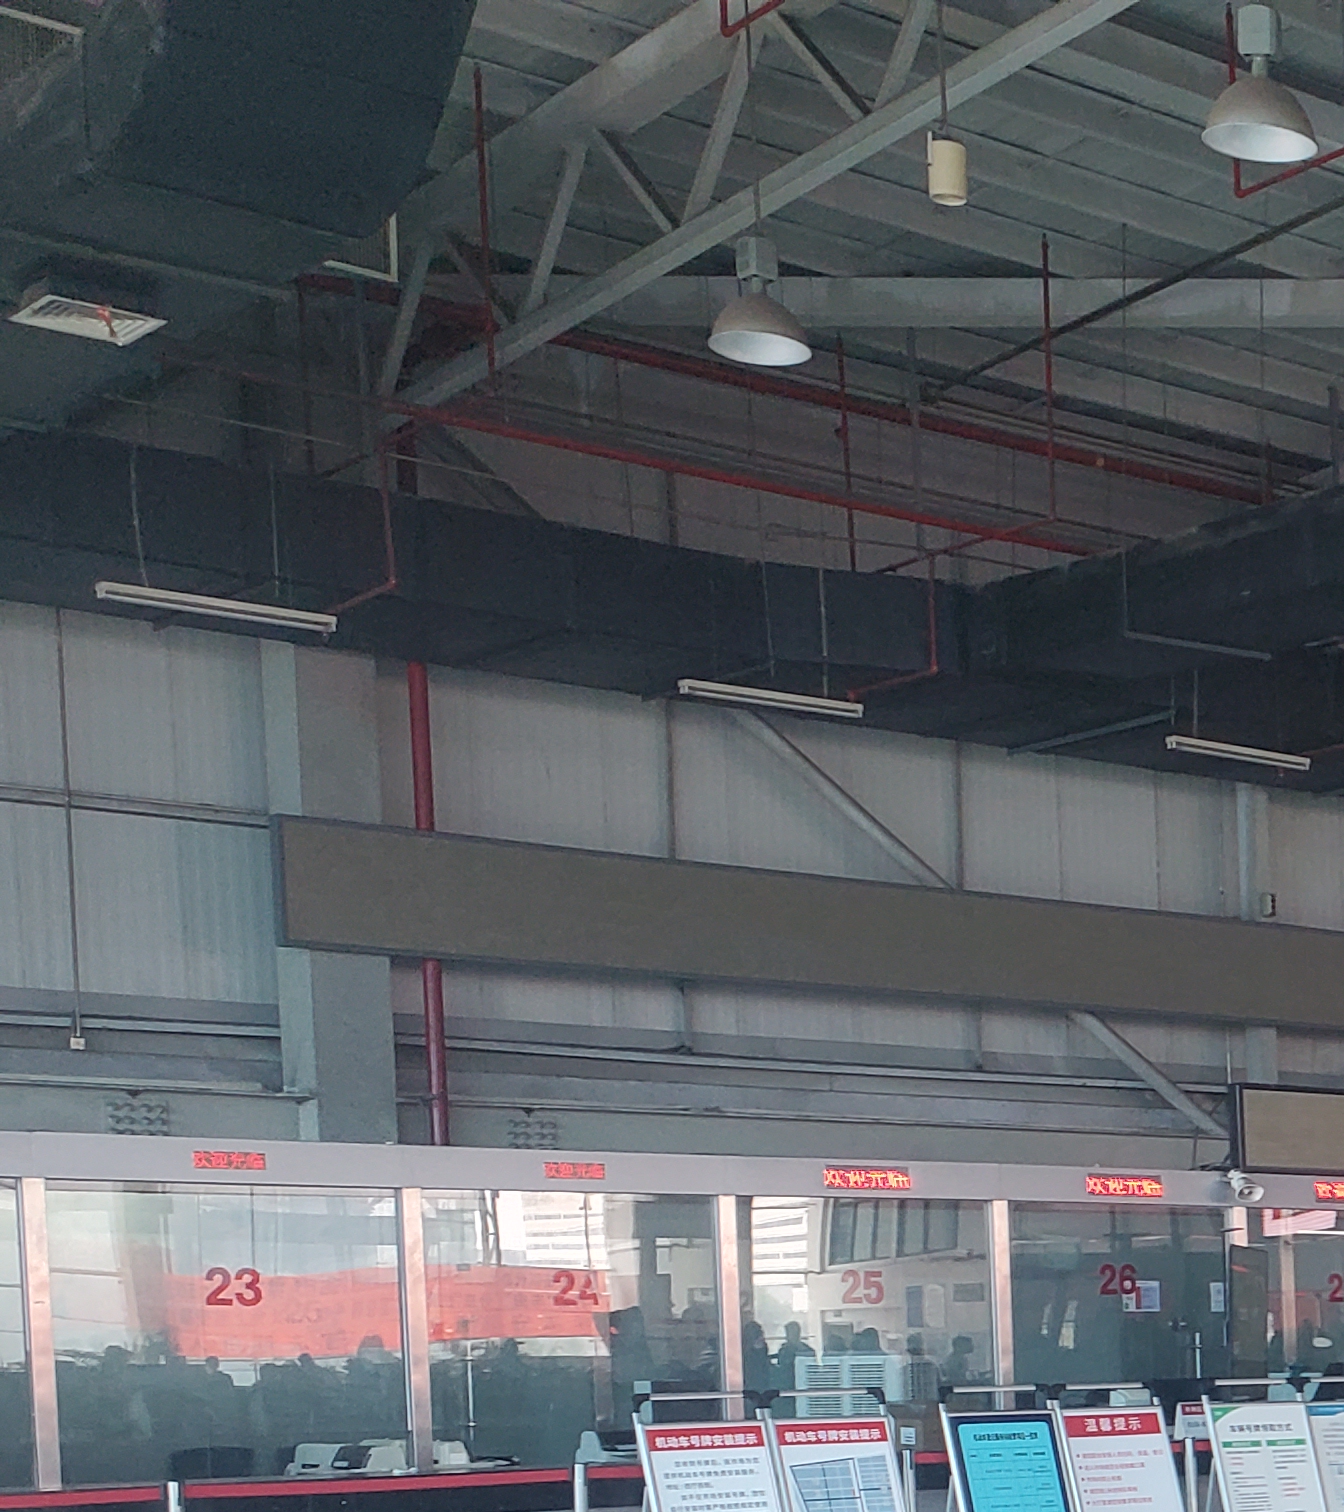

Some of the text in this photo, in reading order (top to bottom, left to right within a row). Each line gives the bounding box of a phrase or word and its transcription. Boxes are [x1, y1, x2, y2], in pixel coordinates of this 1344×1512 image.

[192, 1151, 266, 1169] 欢迎光临
[205, 1267, 264, 1306] 23
[552, 1270, 598, 1306] 24
[841, 1270, 884, 1304] 25
[1099, 1264, 1136, 1295] 26
[784, 1429, 882, 1442] 机动车号牌安装提示
[1084, 1417, 1141, 1432] 温馨提示
[655, 1433, 758, 1448] 机动车号牌安装提示
